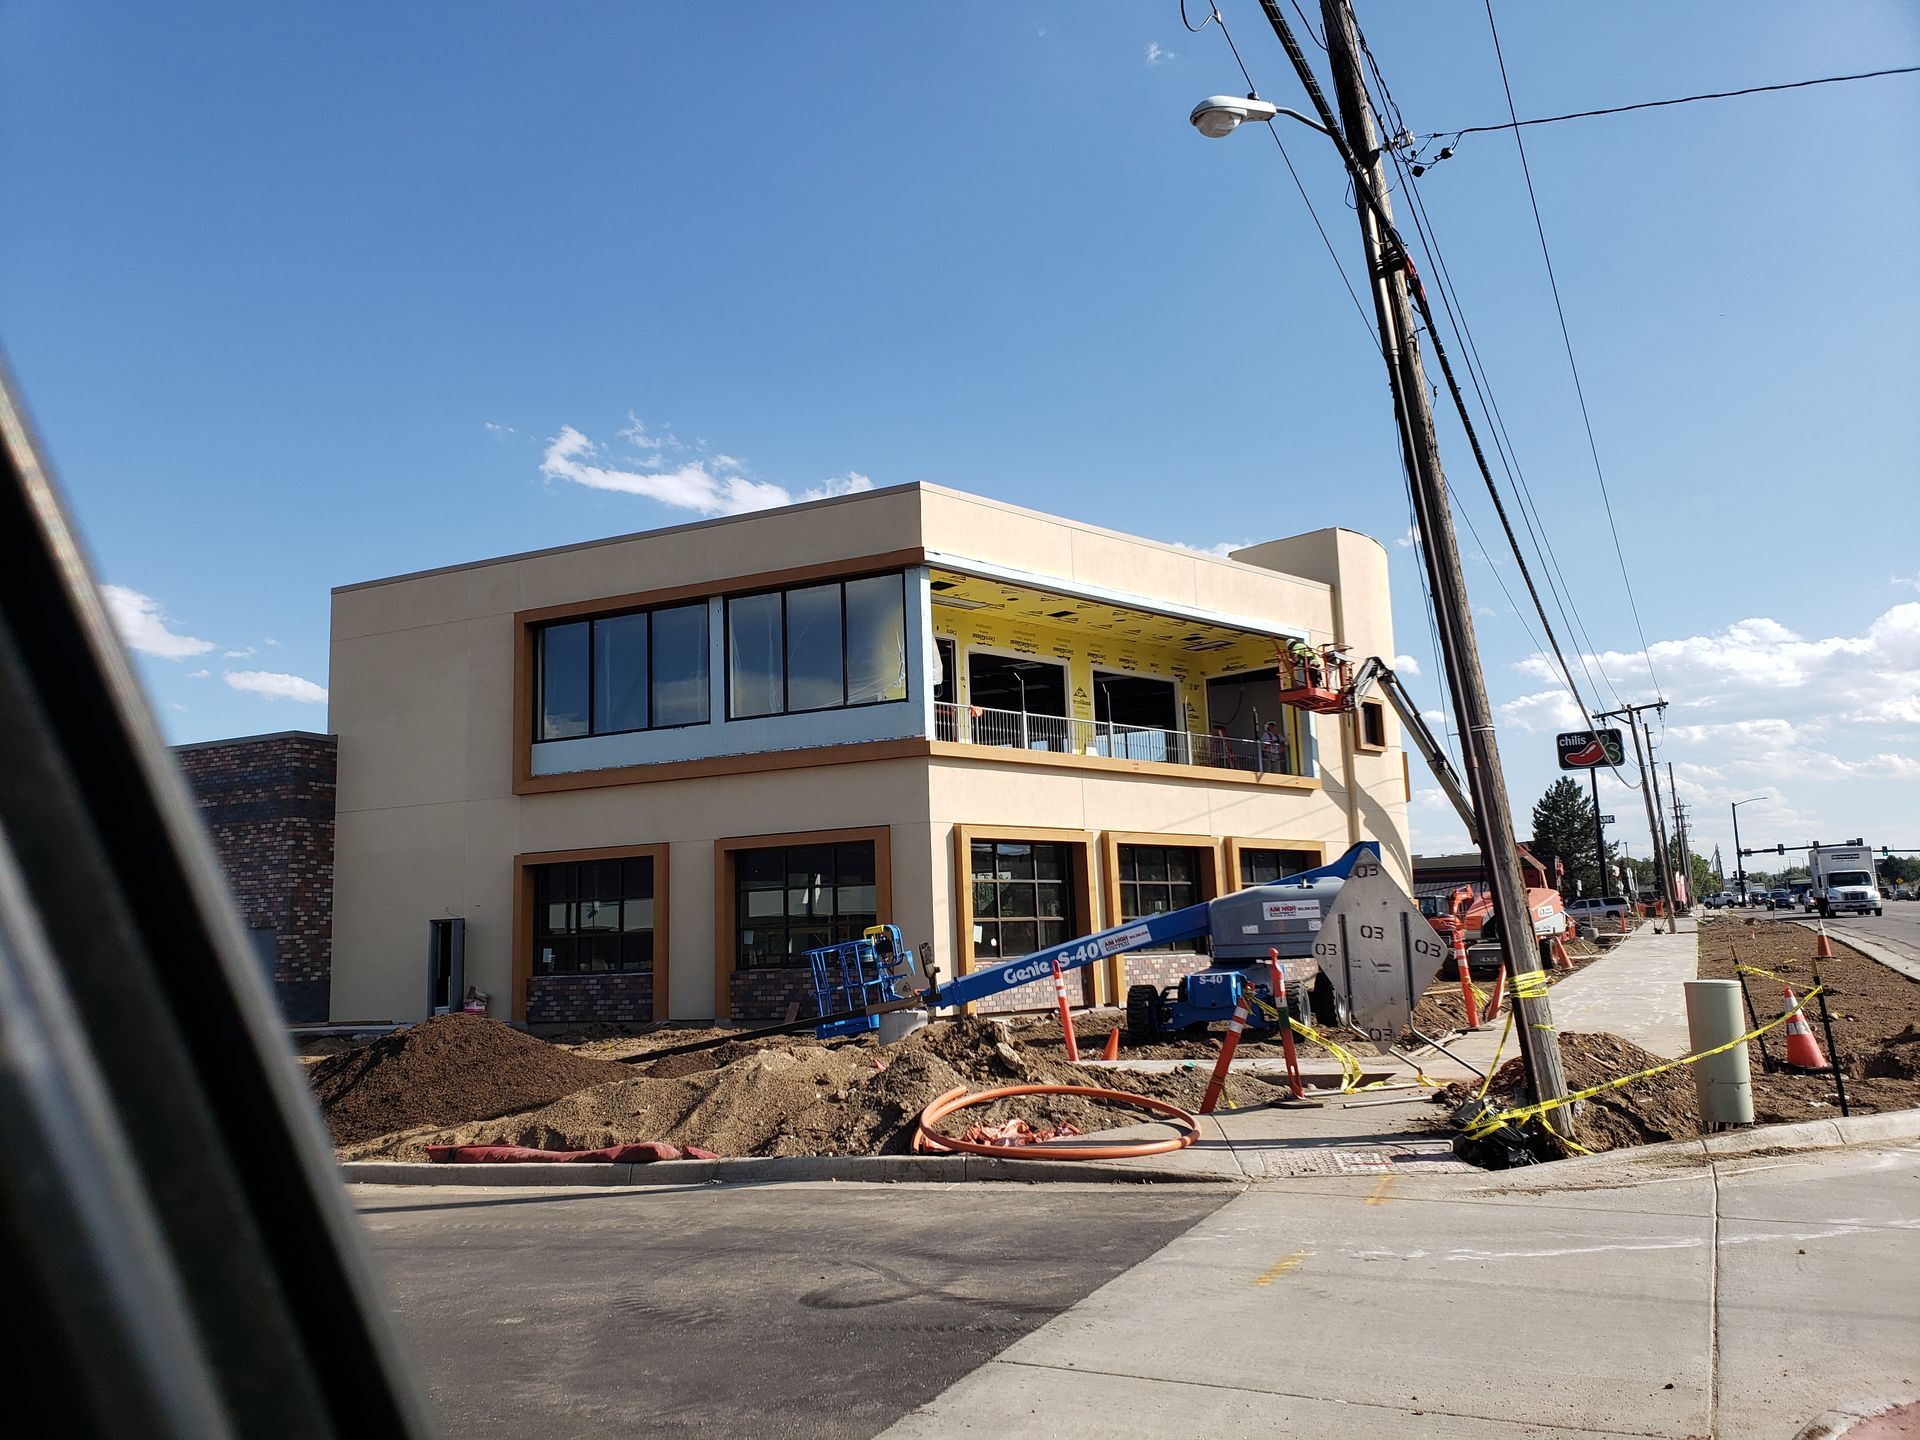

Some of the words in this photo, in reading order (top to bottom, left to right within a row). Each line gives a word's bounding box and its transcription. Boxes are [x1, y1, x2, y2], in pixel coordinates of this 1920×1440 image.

[1559, 735, 1587, 747] chilis
[1003, 961, 1051, 984] Genie
[1057, 942, 1099, 968] S-40
[1198, 975, 1223, 985] S-40
